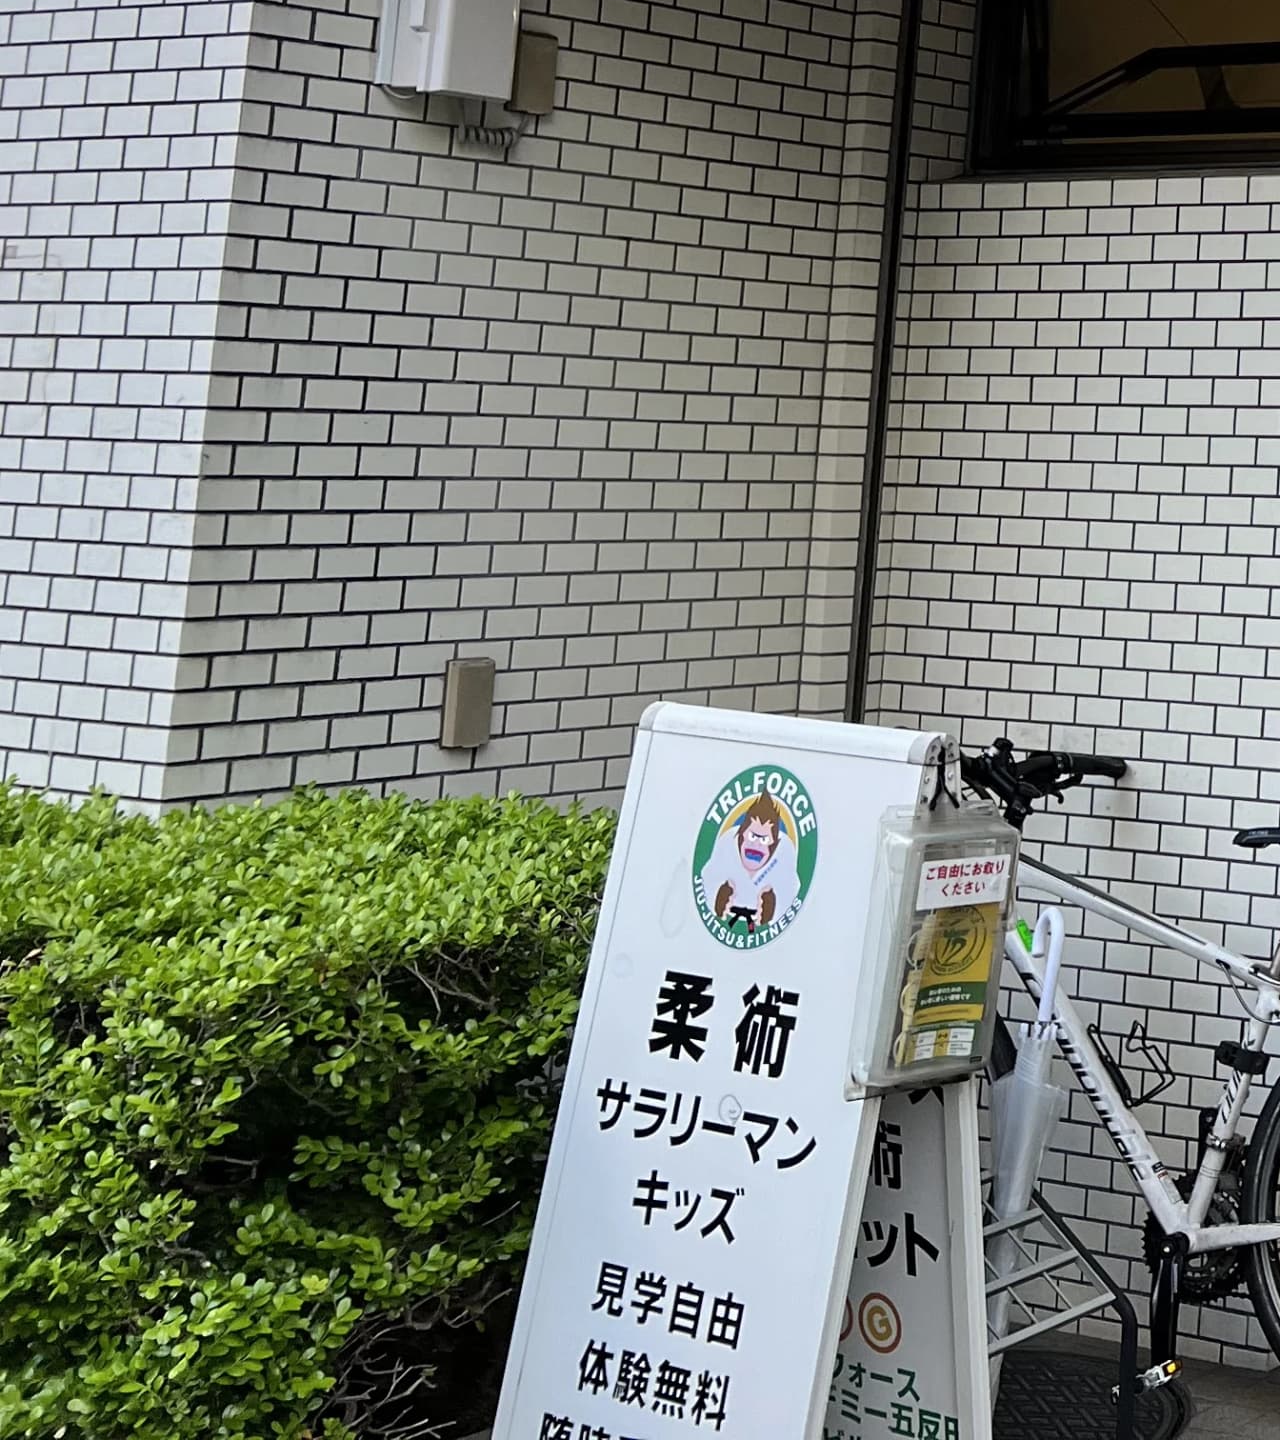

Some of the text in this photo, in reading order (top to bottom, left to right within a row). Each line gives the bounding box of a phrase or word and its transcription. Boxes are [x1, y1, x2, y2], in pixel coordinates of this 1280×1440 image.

[707, 771, 816, 838] TRI-FORCE
[926, 860, 1005, 881] ご自由にお取り
[940, 881, 986, 898] ください
[648, 970, 800, 1079] 柔術
[597, 1078, 817, 1169] サラリーマン
[632, 1169, 745, 1244] キッズ
[591, 1262, 746, 1350] 見学自由
[577, 1338, 731, 1431] 体験無料
